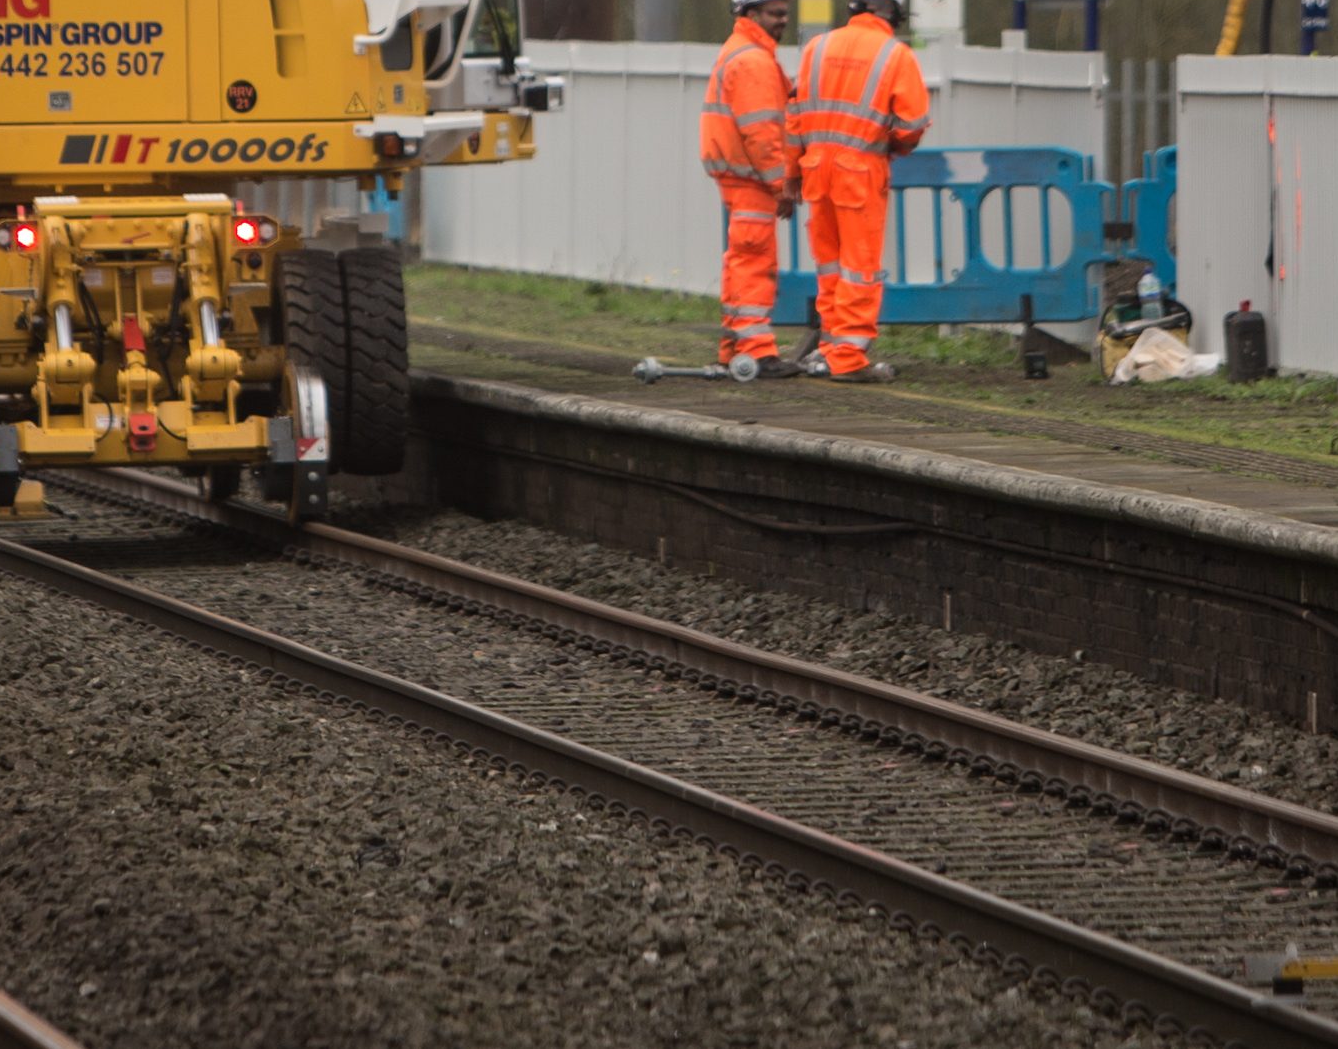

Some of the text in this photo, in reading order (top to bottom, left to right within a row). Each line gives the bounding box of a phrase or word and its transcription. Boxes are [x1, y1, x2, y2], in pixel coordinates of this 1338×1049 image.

[61, 21, 163, 45] GROUP
[58, 52, 106, 77] 236
[117, 51, 165, 76] 507
[137, 133, 329, 164] T 10000fs
